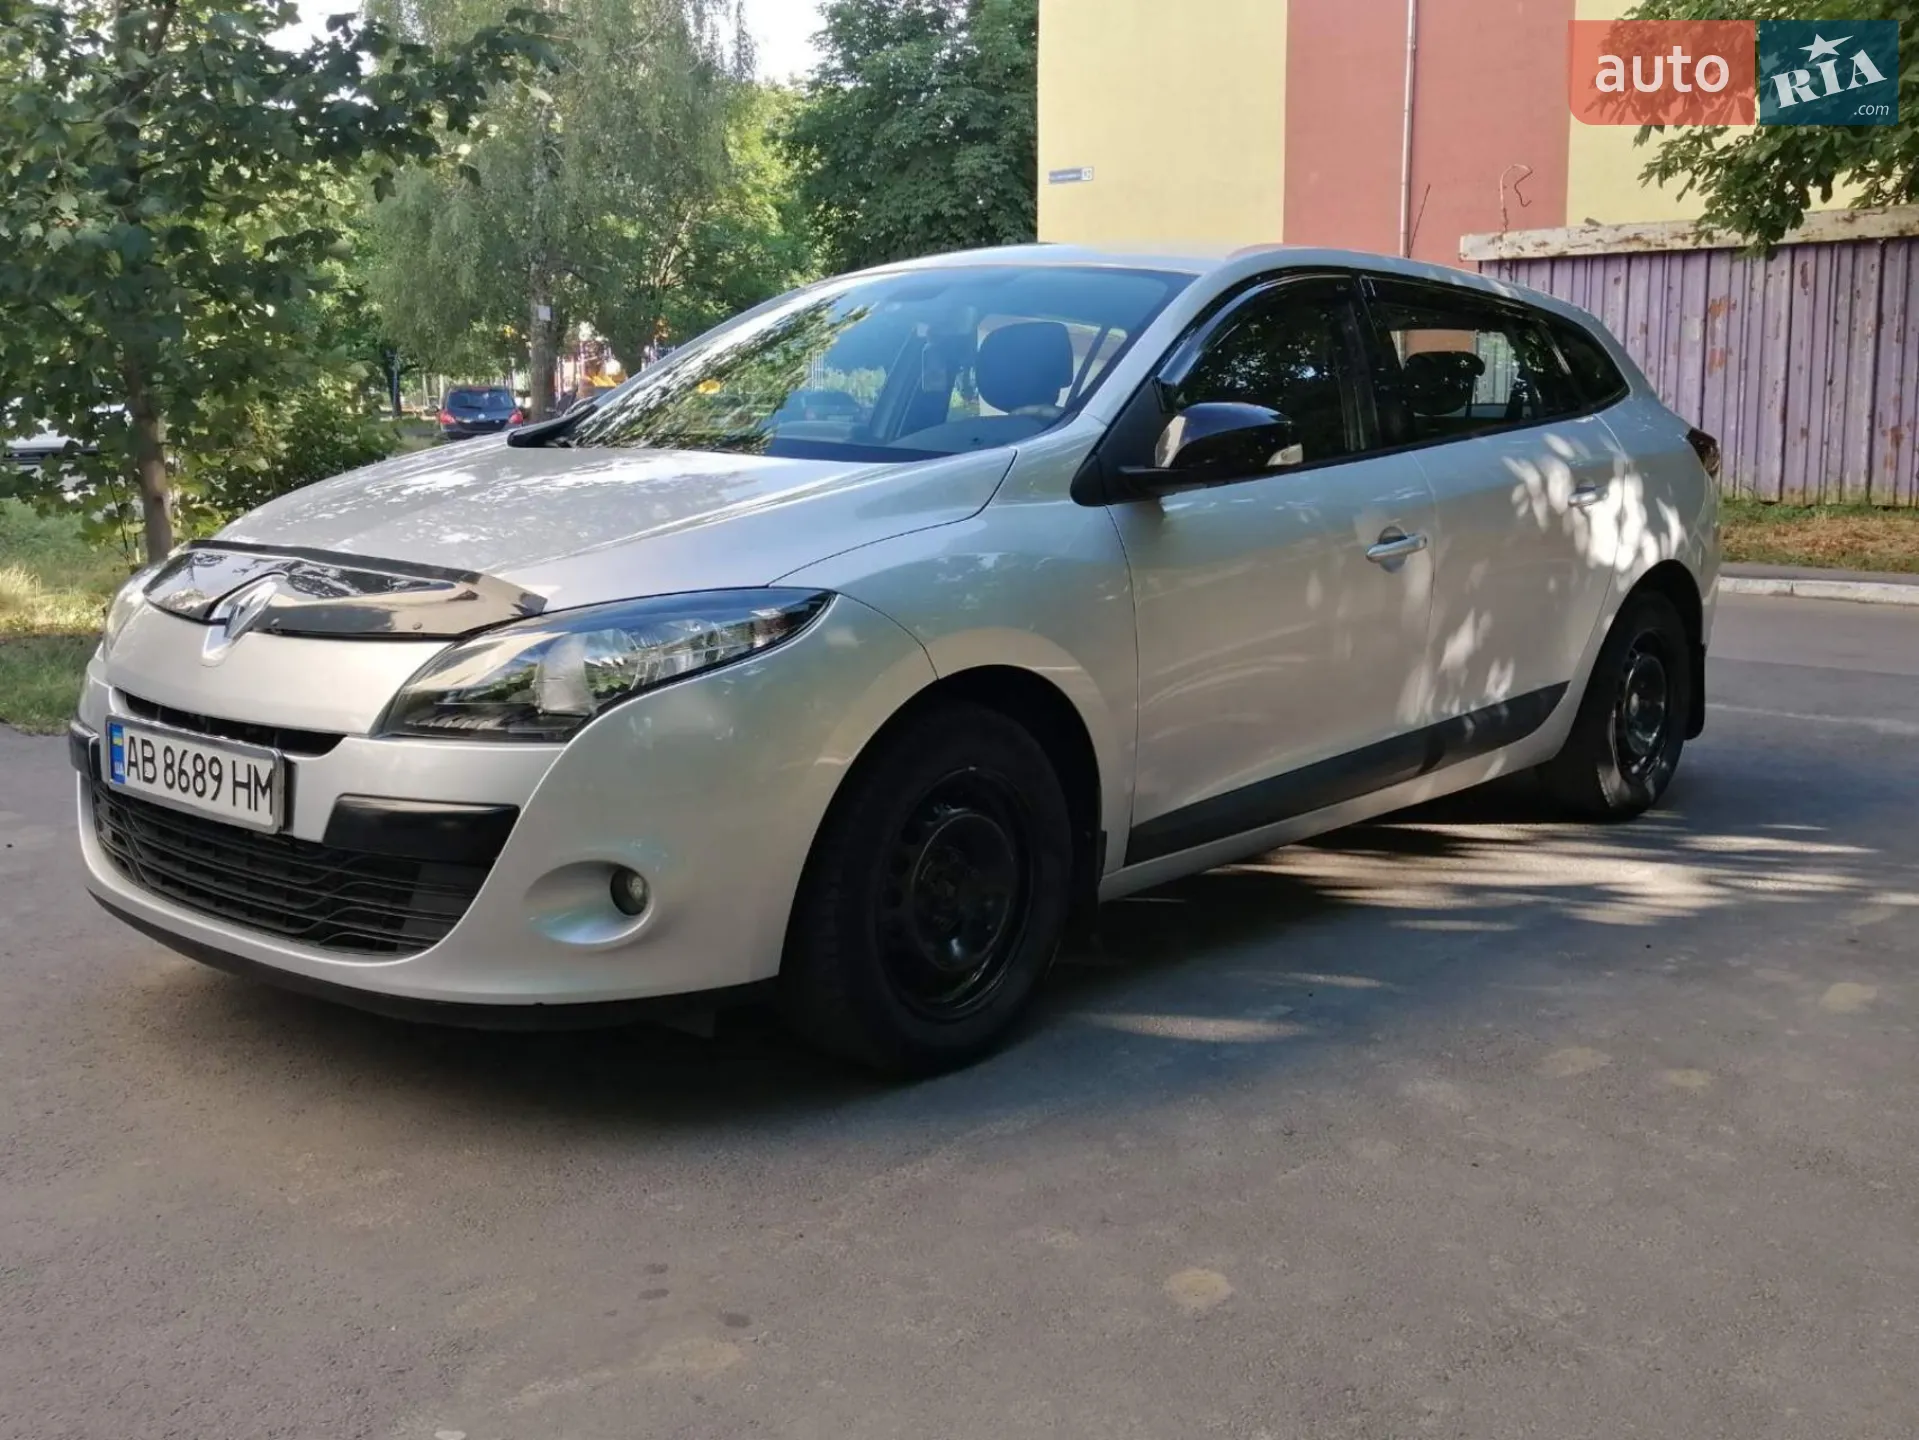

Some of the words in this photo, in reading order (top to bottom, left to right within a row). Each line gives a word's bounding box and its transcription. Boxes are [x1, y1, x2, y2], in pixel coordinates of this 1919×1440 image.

[127, 736, 157, 785] AB
[163, 745, 222, 801] 8689
[232, 760, 273, 815] HM
